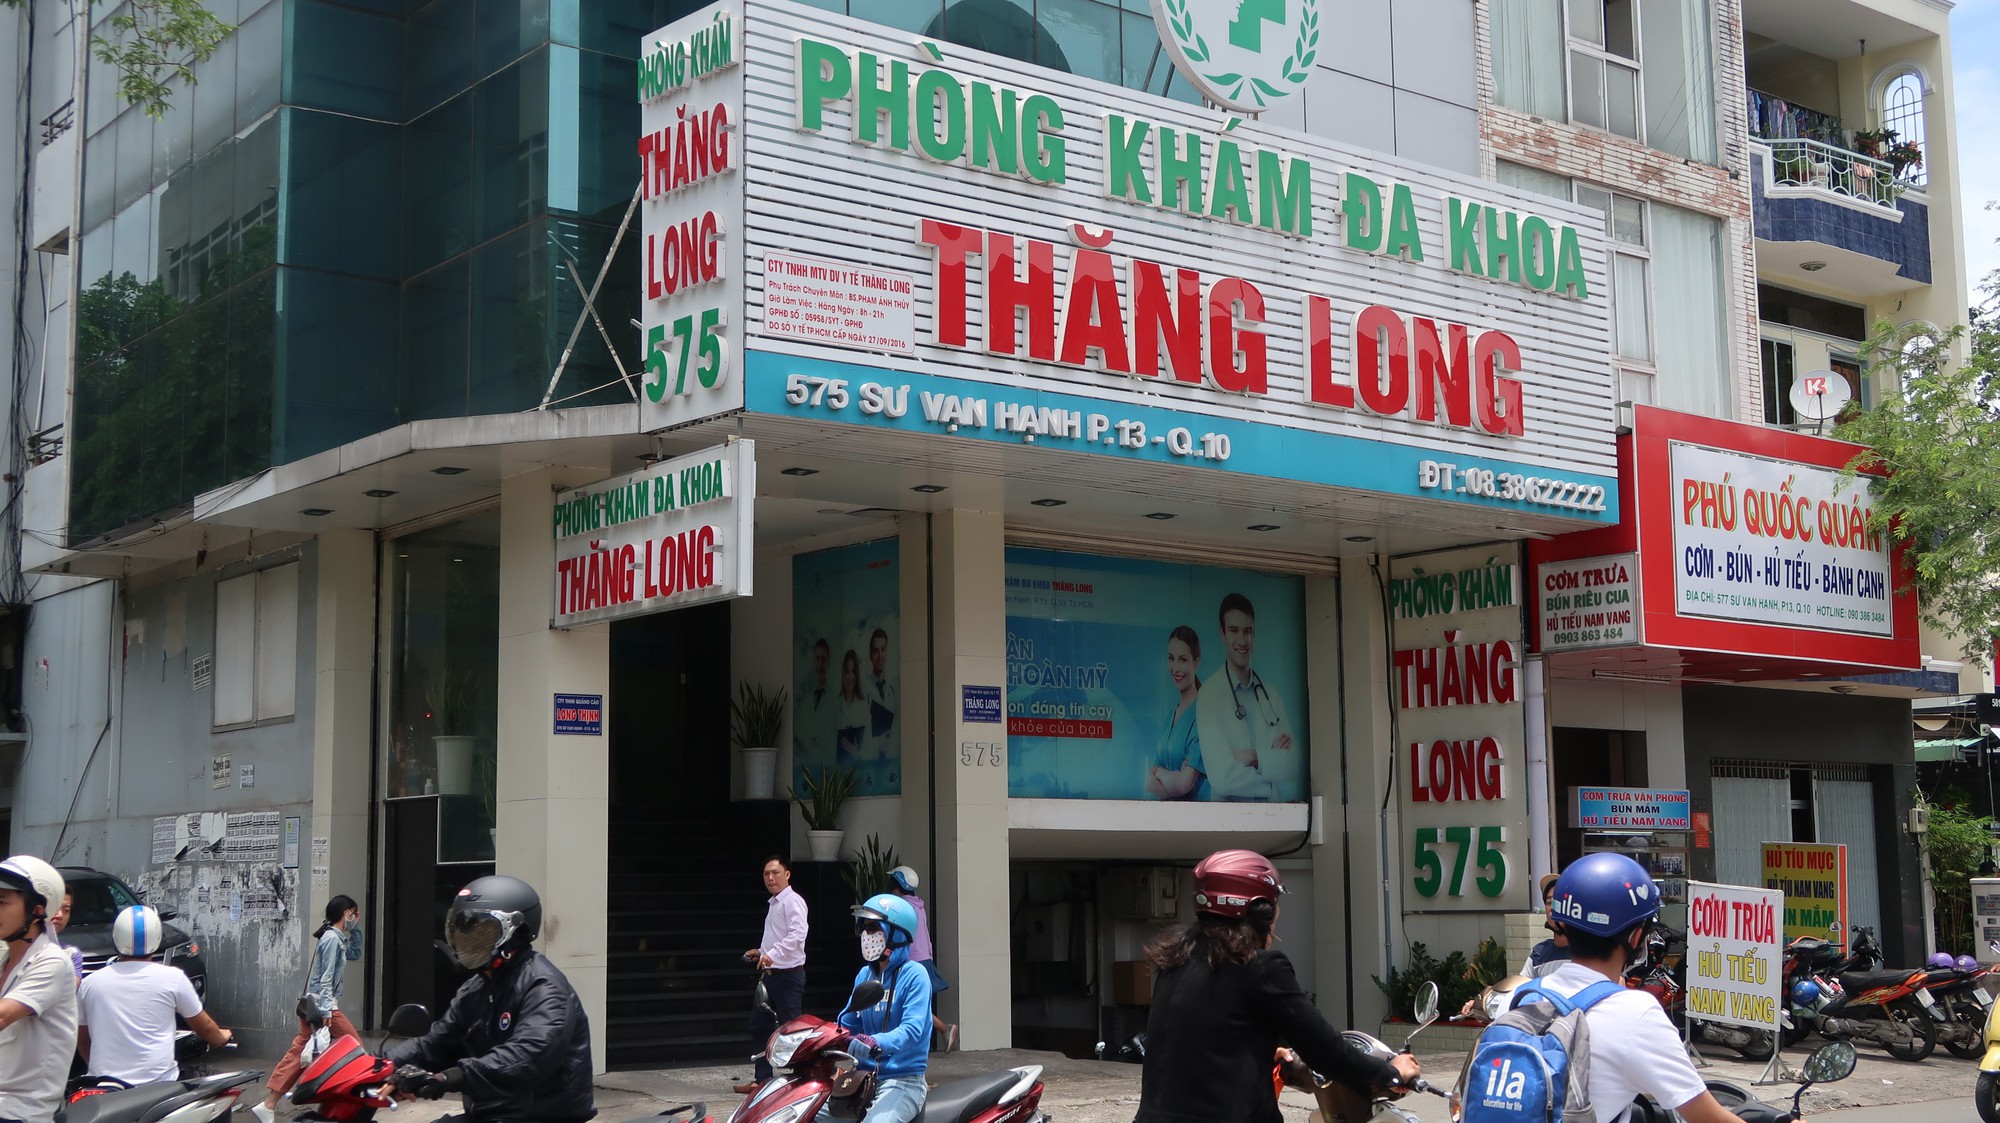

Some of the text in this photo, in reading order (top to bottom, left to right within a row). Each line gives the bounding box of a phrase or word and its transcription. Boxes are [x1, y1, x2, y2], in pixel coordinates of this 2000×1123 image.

[637, 10, 740, 106] PHÒNG KHÁM
[637, 102, 737, 201] THĂNG
[794, 38, 1588, 301] PHÒNG KHÁM ĐA KHOA
[647, 210, 727, 302] LONG
[768, 259, 911, 295] CTY TNHH MTV DV Y TẾ THĂNG LONG
[768, 280, 781, 291] Phụ
[783, 282, 802, 293] Trách
[803, 286, 829, 299] Chuyên
[829, 290, 844, 300] Môn
[768, 294, 885, 319] Giờ Làm Việc Hàng Ngày 8h 21h
[768, 308, 863, 329] GPHĐ SỐ 05958/SYT GPHĐ
[768, 321, 906, 349] DO SỞ Y TẾ TP.HCM CẤP NGÀY 27/09/2016
[915, 218, 1525, 438] THĂNG LONG
[644, 307, 729, 404] 575
[785, 374, 1231, 461] 575 SƯ VẠN HẠNH P.13 Q.10
[553, 459, 731, 539] PHÒNG KHÁM ĐA KHOA
[1683, 471, 1738, 532] PHÚ
[1743, 474, 1813, 543] QUỐC
[558, 525, 722, 615] THĂNG LONG
[1545, 562, 1629, 591] CƠM TRƯA
[1685, 543, 1885, 601] CƠM BÚN HỦ TIẾU BÁNH CANH
[1022, 579, 1093, 593] ĐA KHOA THĂNG LONG
[1389, 556, 1516, 619] PHÒNG KHÁM
[1546, 589, 1630, 611] BÚN RIÊU CUA
[1546, 610, 1631, 631] HỦ TIẾU NAM VANG
[1686, 590, 1699, 602] ĐỊA
[1717, 593, 1729, 605] 577
[1730, 594, 1741, 606] SƯ
[1742, 597, 1757, 610] VẠN
[1759, 599, 1780, 613] HẠNH,
[1781, 602, 1795, 613] P13,
[1796, 603, 1811, 614] Q.10
[1816, 606, 1847, 619] HOTLINE:
[1847, 609, 1858, 620] 090
[1860, 611, 1871, 622] 386
[1871, 612, 1885, 623] 3484
[1554, 627, 1624, 644] 0903 863 484
[1077, 662, 1109, 689] MỸ
[1394, 630, 1519, 709] THĂNG
[556, 708, 600, 724] LONG THỊNH
[985, 699, 1000, 710] LONG
[1030, 699, 1066, 718] đáng
[1069, 702, 1085, 717] tin
[1089, 704, 1113, 720] cậy
[1011, 719, 1104, 737] khỏe của bạn
[961, 742, 1003, 767] 575
[1410, 736, 1506, 803] LONG
[1582, 790, 1604, 801] CƠM
[1606, 791, 1632, 802] TRƯA
[1611, 802, 1632, 813] BÚN
[1582, 813, 1687, 826] HỦ TIẾU NAM VANG
[1413, 826, 1510, 897] 575
[1766, 845, 1834, 874] HỦ TÍU MỰC
[1794, 880, 1812, 898] NAM
[1813, 880, 1835, 899] VANG
[1562, 893, 1583, 920] ila
[1691, 893, 1728, 938] CƠM
[1732, 896, 1776, 944] TRƯA
[1799, 904, 1834, 928] MẮM
[1698, 942, 1767, 985] HỦ TIẾU
[1689, 986, 1775, 1024] NAM VANG
[1486, 1057, 1526, 1100] ila
